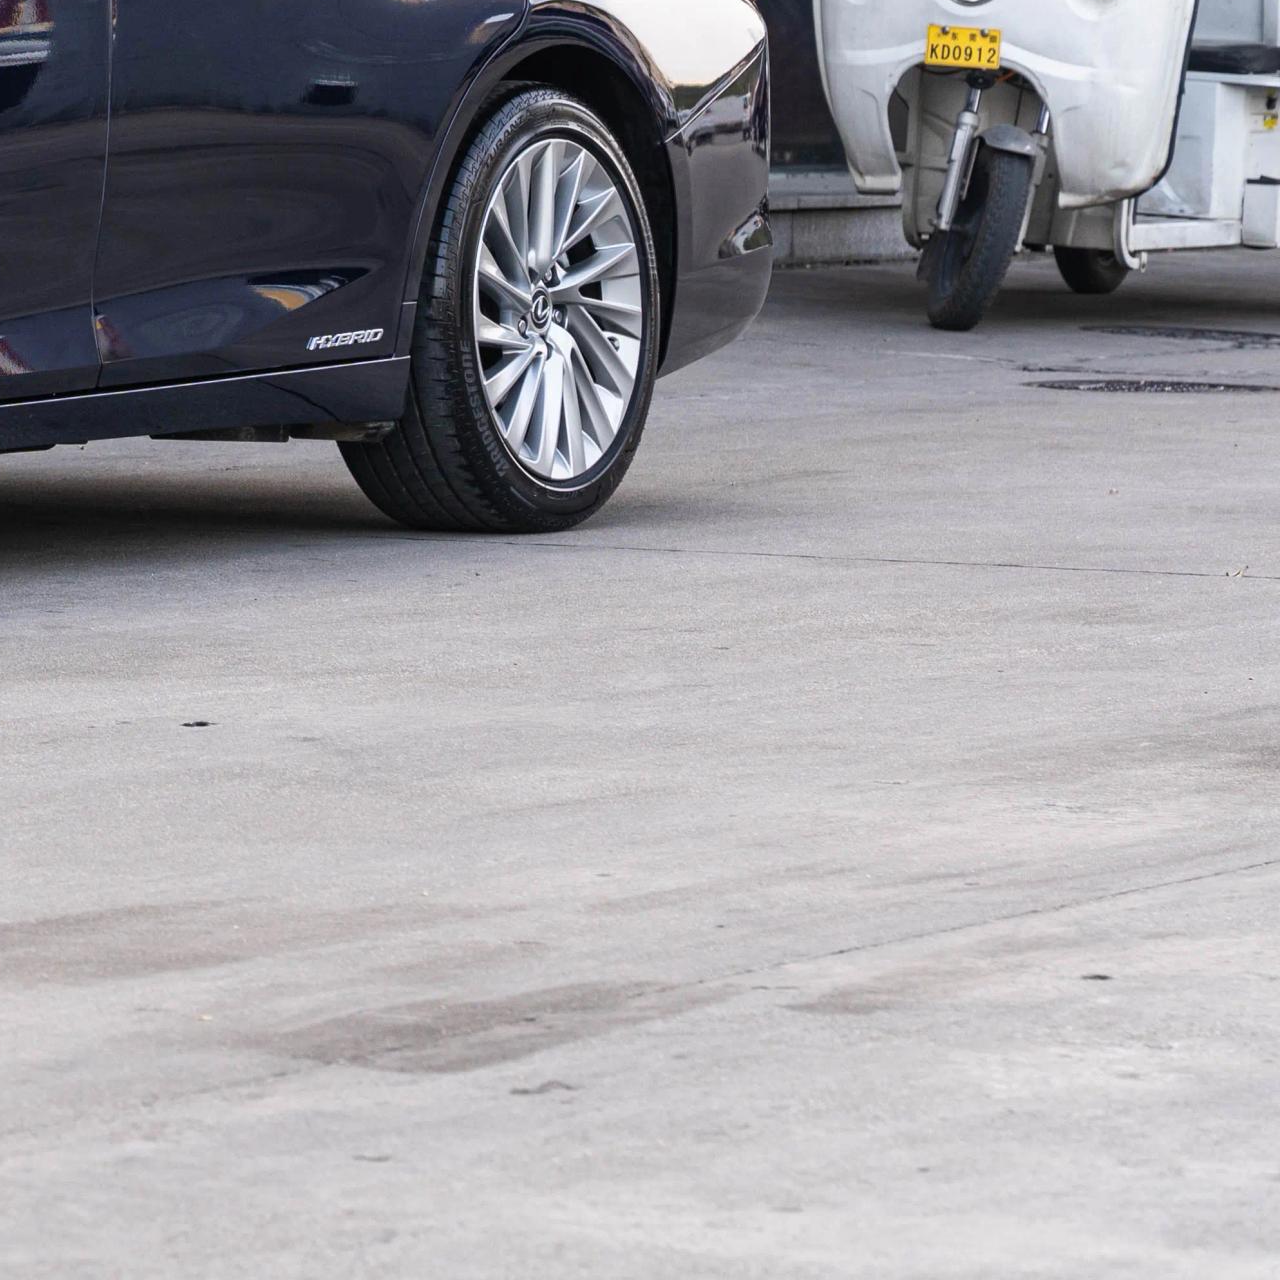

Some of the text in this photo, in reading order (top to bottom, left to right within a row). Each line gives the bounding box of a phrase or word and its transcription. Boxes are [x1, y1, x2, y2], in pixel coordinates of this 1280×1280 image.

[929, 43, 997, 64] KD0912
[306, 327, 384, 351] HYBRID
[460, 339, 508, 477] BRIDGESTONE
